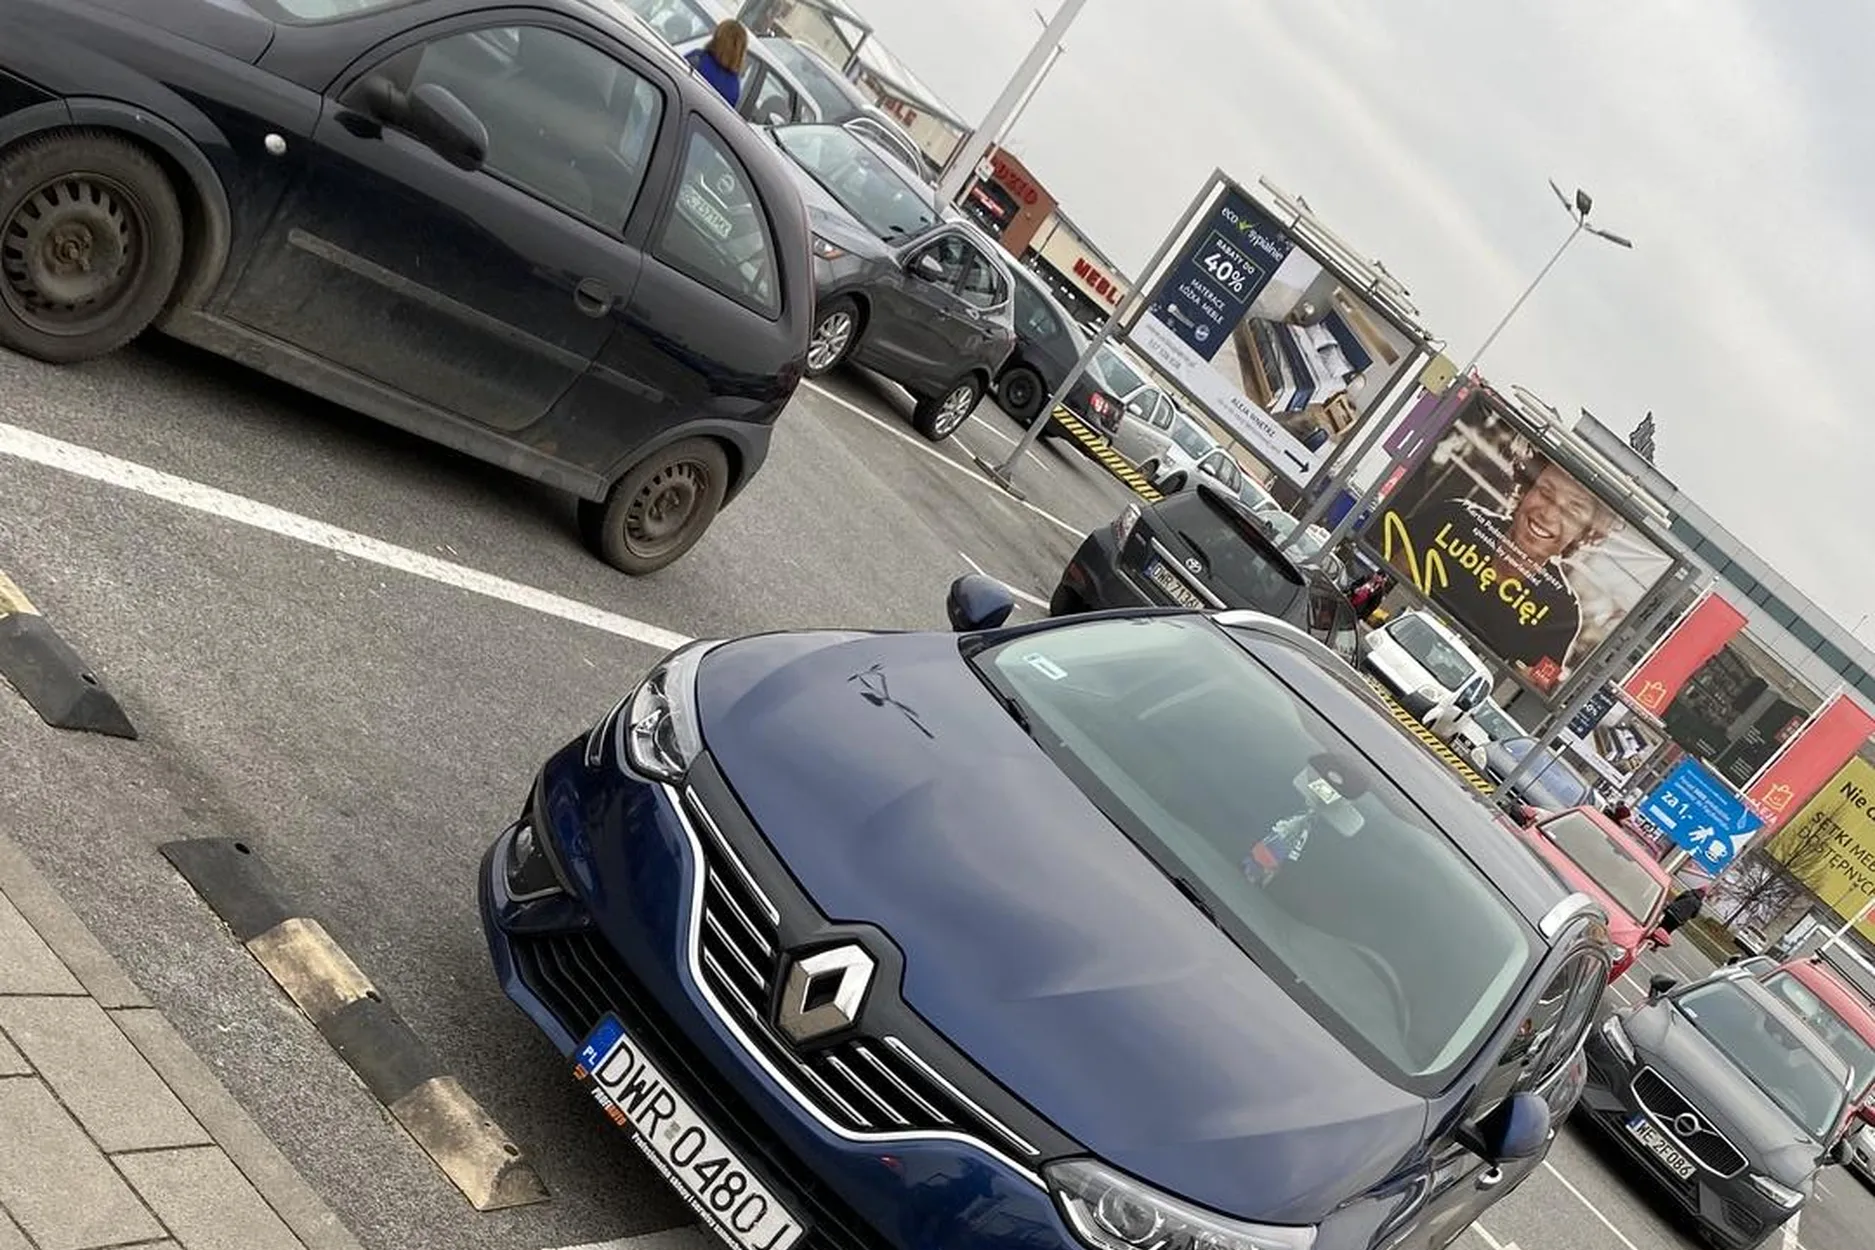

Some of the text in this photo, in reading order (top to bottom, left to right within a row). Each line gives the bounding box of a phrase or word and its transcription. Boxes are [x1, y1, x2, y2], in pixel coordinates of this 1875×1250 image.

[1221, 207, 1239, 224] eco
[1204, 253, 1245, 293] 40%
[1434, 522, 1549, 626] Lubię Cię!
[1661, 791, 1680, 808] za
[1840, 781, 1867, 809] Nie
[1811, 810, 1853, 849] SETKI
[582, 1045, 598, 1066] PL
[595, 1040, 676, 1140] DWR
